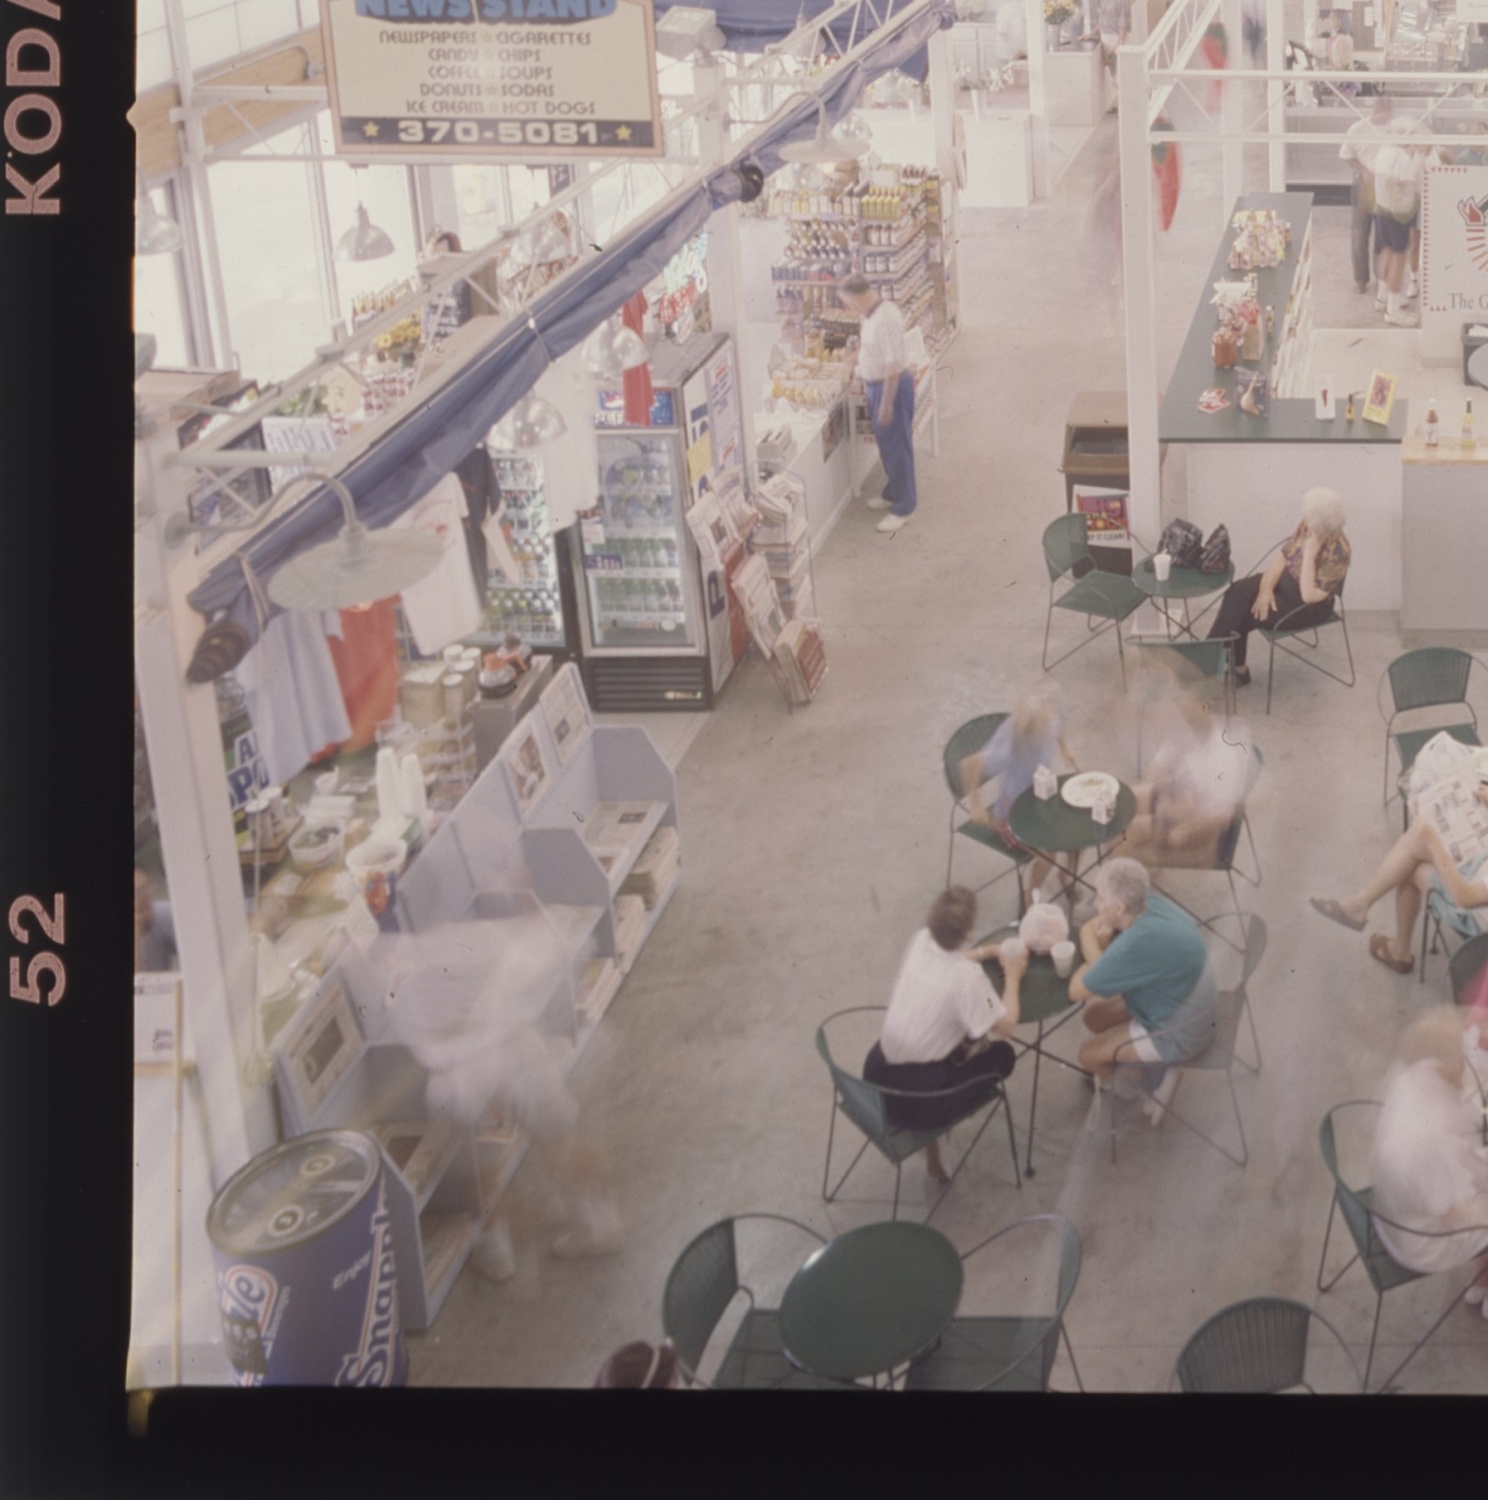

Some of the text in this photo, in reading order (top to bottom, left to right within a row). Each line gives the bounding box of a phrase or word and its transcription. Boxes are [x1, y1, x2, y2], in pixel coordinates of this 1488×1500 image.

[379, 30, 592, 46] NEWSPAPERS CIGARETTES
[428, 47, 541, 63] CANDY CHIPS
[499, 66, 552, 80] SOUPS
[420, 83, 555, 97] DONUTS SODAS
[406, 101, 596, 116] ICE CREAM HOT DOGS
[397, 120, 600, 145] 370-5081
[1448, 292, 1475, 311] The
[8, 893, 67, 1007] 52
[332, 1248, 373, 1291] Enjoy
